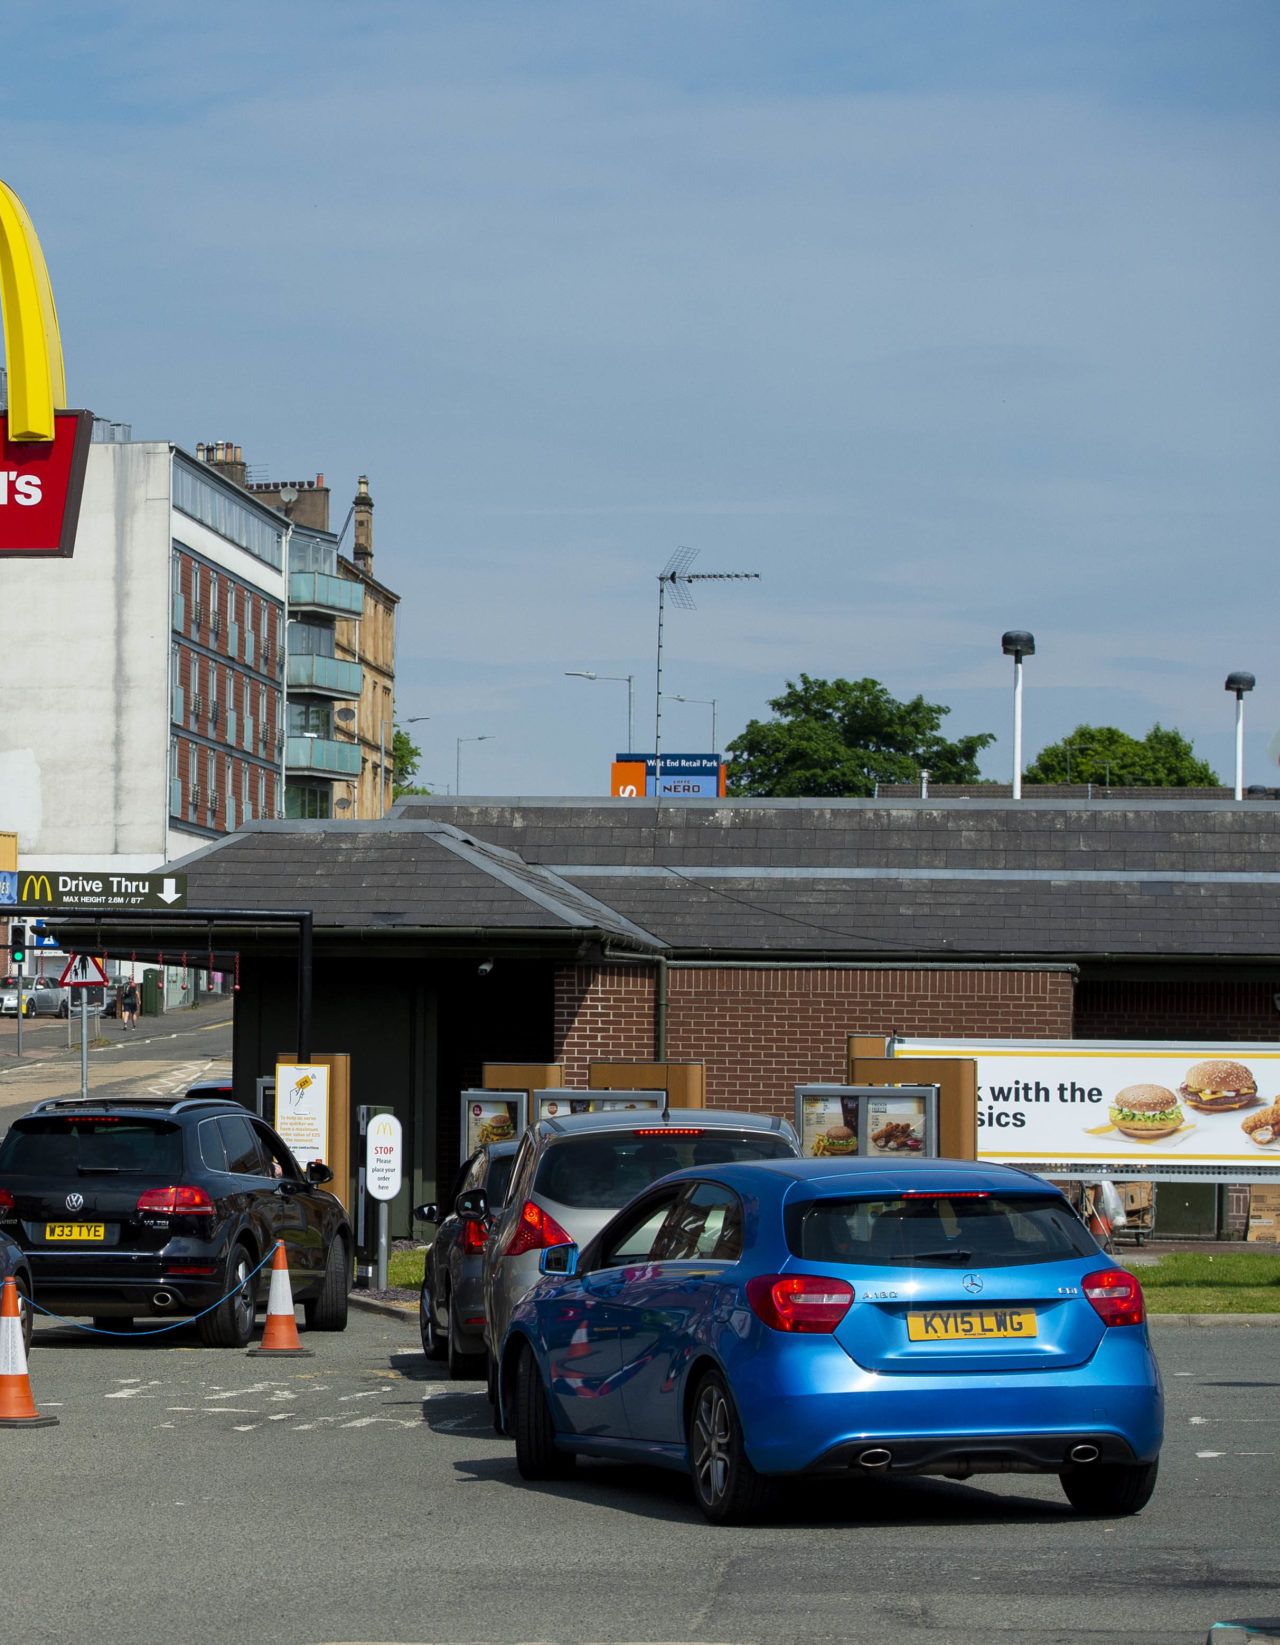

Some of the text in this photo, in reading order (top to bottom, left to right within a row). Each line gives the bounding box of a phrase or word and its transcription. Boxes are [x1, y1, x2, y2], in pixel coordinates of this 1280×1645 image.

[667, 759, 679, 767] End
[681, 759, 700, 767] Retail
[702, 759, 718, 768] Park
[663, 785, 701, 793] NERO
[58, 876, 149, 893] Drive Thru
[63, 895, 79, 903] MAX
[108, 896, 124, 904] 2.6M
[989, 1080, 1050, 1103] with
[1057, 1081, 1103, 1103] the
[977, 1105, 1026, 1128] sics
[374, 1146, 394, 1155] STOP
[48, 1224, 102, 1238] W33 TYE
[922, 1311, 1024, 1334] KY15 LWG
